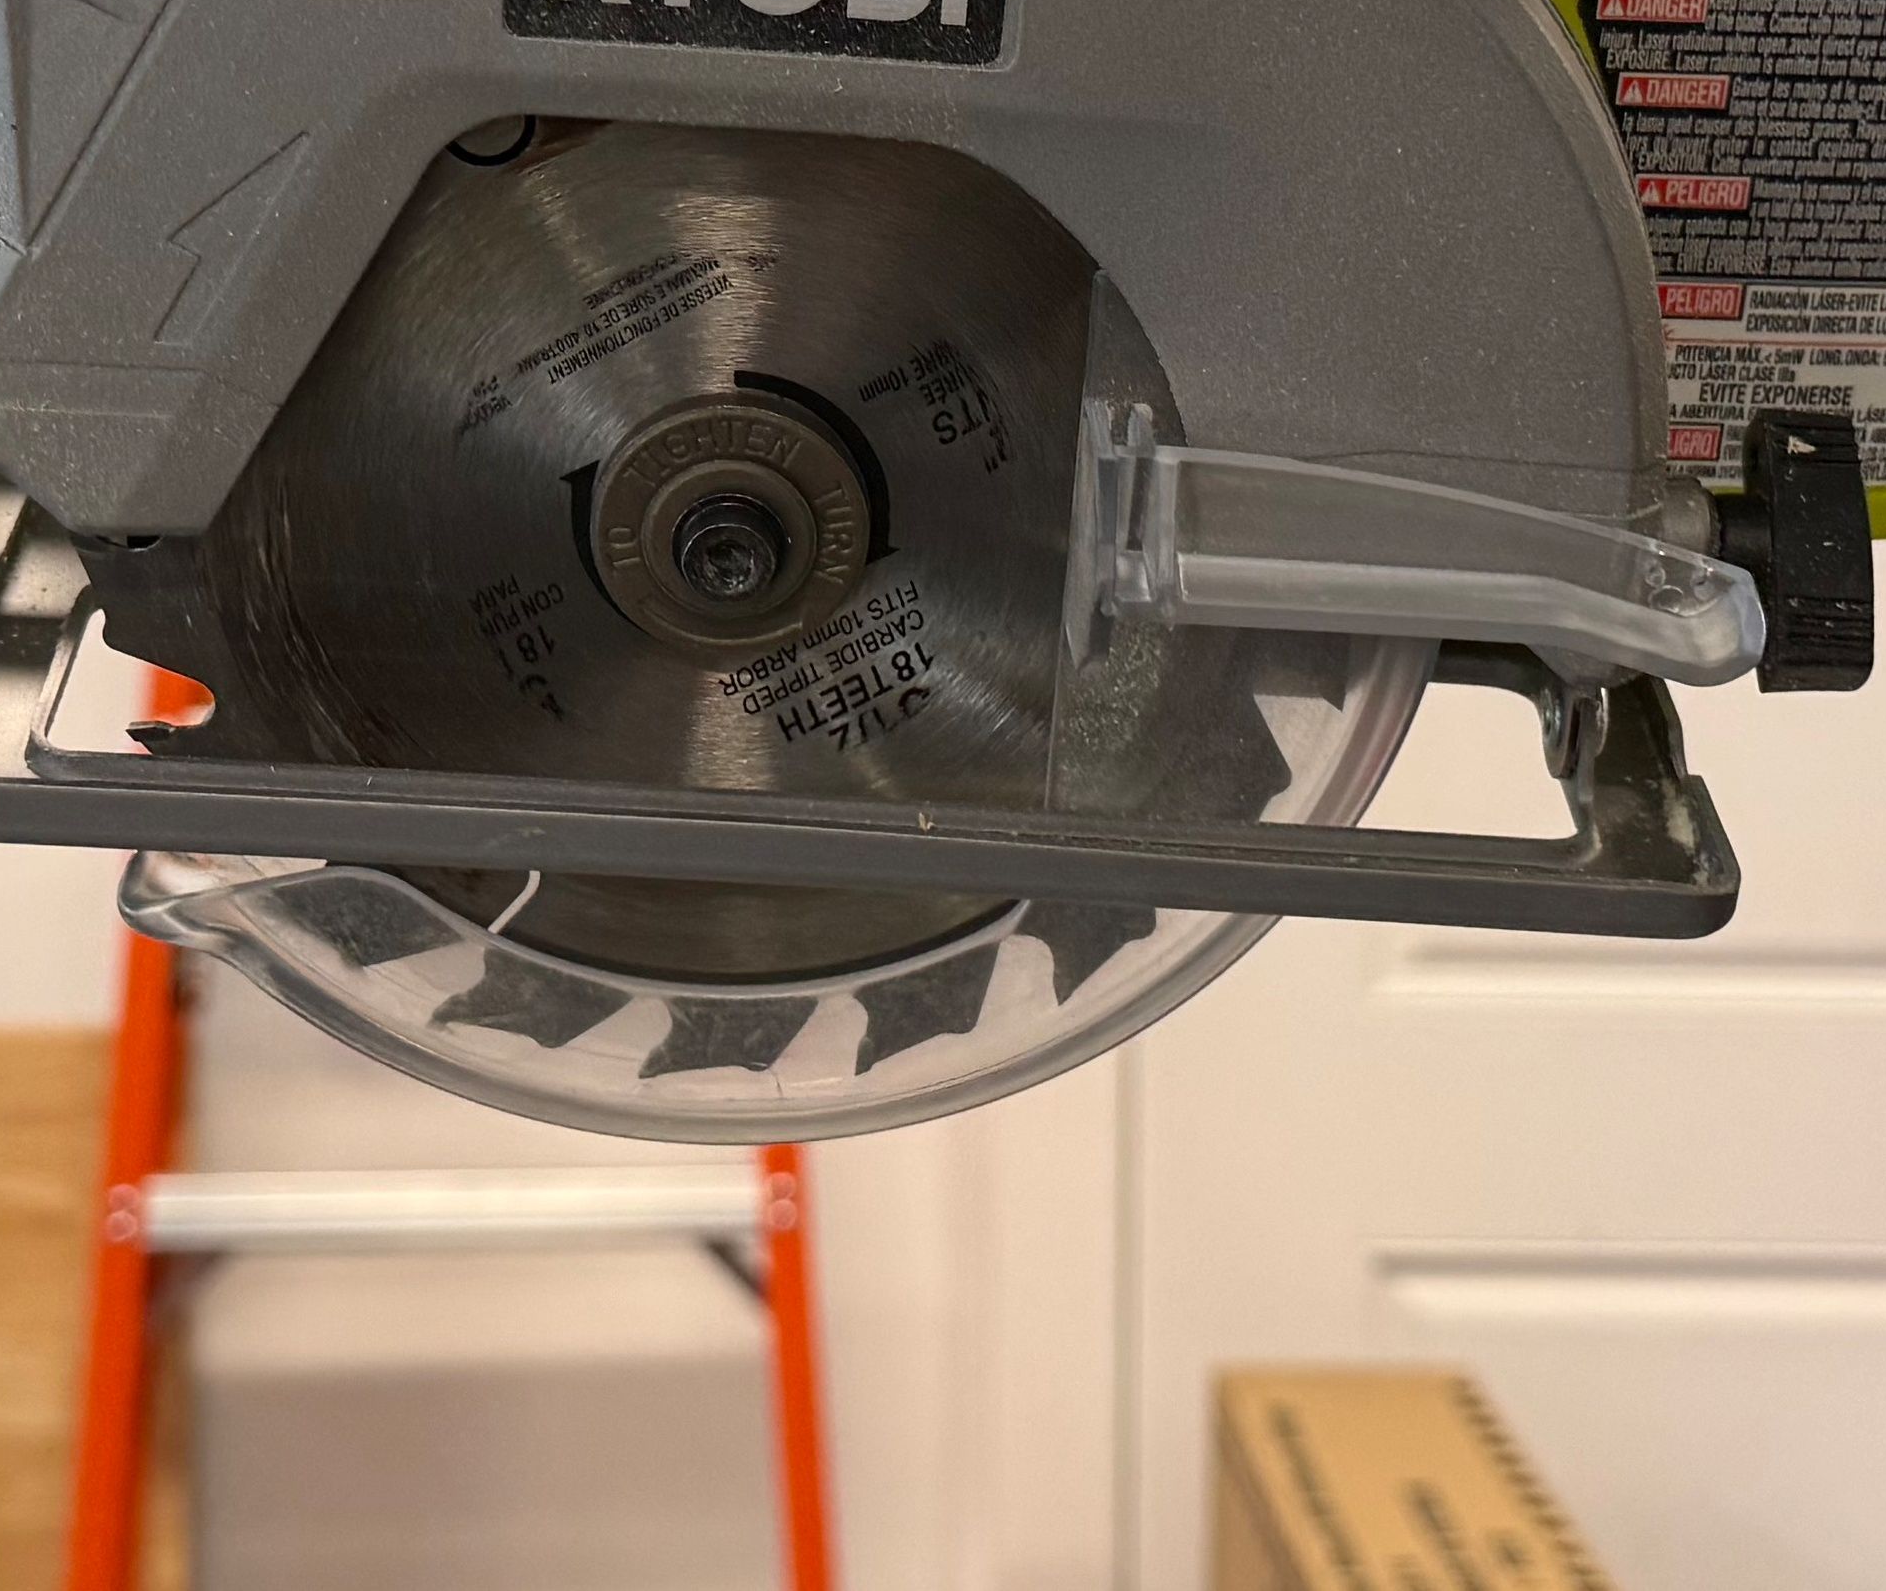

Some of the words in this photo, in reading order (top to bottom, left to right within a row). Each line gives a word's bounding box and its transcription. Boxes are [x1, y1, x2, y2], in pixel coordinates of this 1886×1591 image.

[1638, 29, 1670, 50] Laser
[1646, 79, 1721, 105] DANGER
[1666, 180, 1742, 207] PELIGRO
[683, 272, 735, 308] VITESSE
[1665, 288, 1735, 314] PELIGRO
[663, 303, 680, 323] DE
[1812, 315, 1857, 334] DIRECTA
[1859, 316, 1874, 334] DE
[548, 315, 661, 385] FONCTIONNEMENT
[1675, 344, 1732, 362] POTENCIA
[859, 366, 909, 402] 10mm
[1738, 366, 1775, 382] CLASE
[1699, 382, 1748, 404] EVITE
[1751, 383, 1853, 406] EXPONERSE
[1679, 405, 1744, 421] ABERTURA
[622, 420, 802, 487] TIGHTEN
[815, 482, 853, 585] TURN
[521, 583, 564, 618] CON
[867, 579, 919, 621] FITS
[517, 624, 555, 664] 18
[802, 609, 864, 650] 10mm
[825, 609, 924, 673] CARBIDE
[718, 642, 797, 697] ARBOR
[891, 641, 934, 682] 18
[743, 662, 823, 716] TIPPED
[777, 664, 894, 743] TEETH
